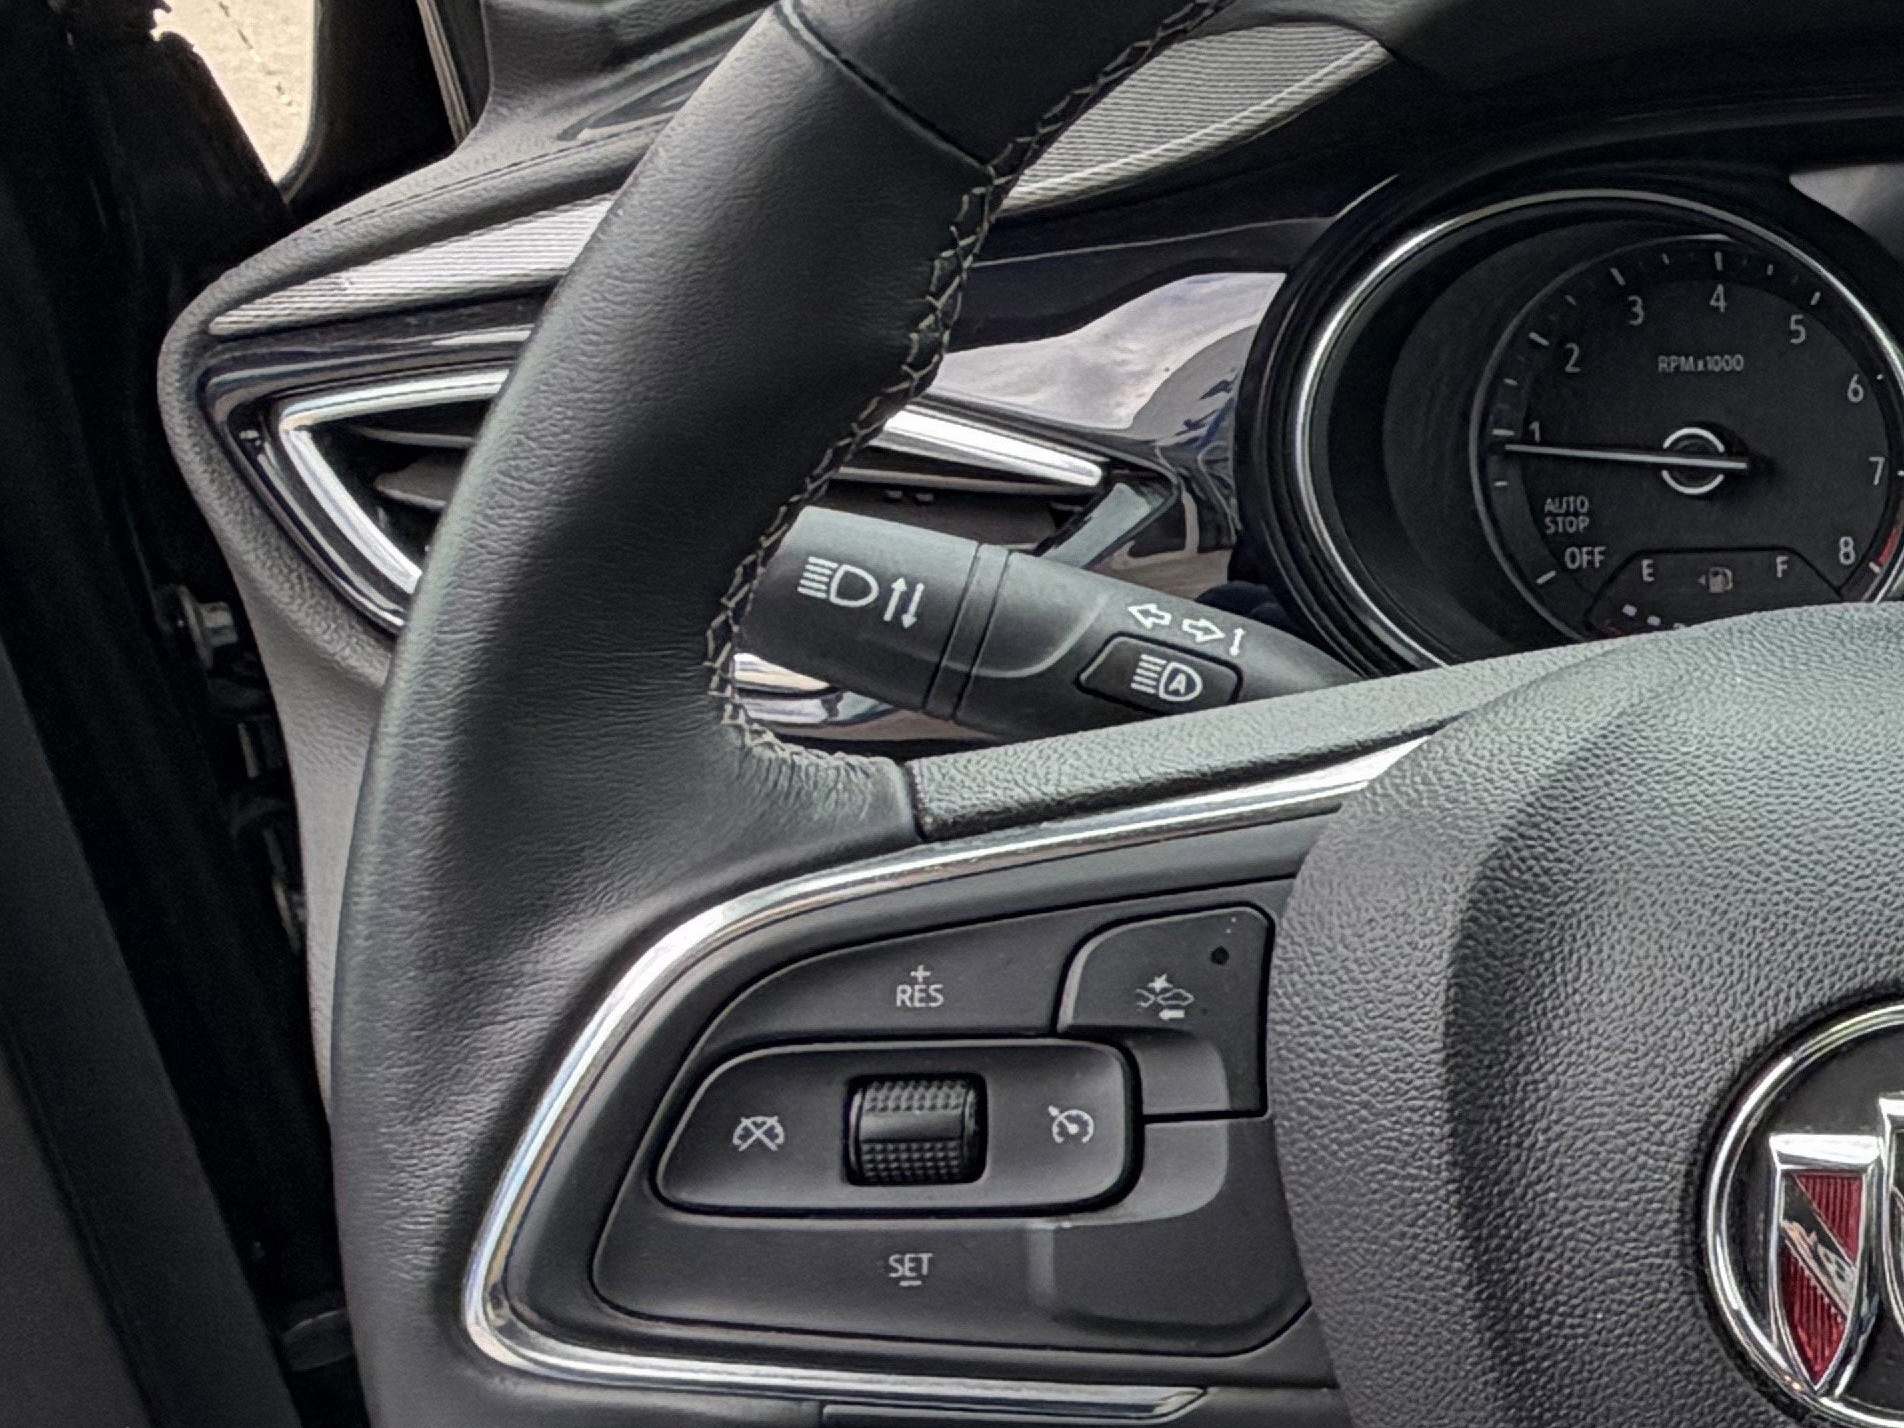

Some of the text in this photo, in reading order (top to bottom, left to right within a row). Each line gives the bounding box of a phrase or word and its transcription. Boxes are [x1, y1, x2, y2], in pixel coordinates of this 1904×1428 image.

[1627, 296, 1646, 326] 3
[1709, 284, 1728, 314] 4
[1788, 314, 1807, 345] 5
[1563, 344, 1582, 374] 2
[1847, 374, 1865, 403] 6
[1528, 421, 1543, 443] 1
[1867, 456, 1885, 486] 7
[1543, 495, 1590, 515] AUTO
[1543, 515, 1590, 534] STOP
[1564, 545, 1606, 571] OFF
[1837, 536, 1856, 565] 8
[1641, 558, 1655, 583] E
[1775, 555, 1789, 579] F
[895, 982, 945, 1009] RES
[888, 1252, 933, 1278] SET
